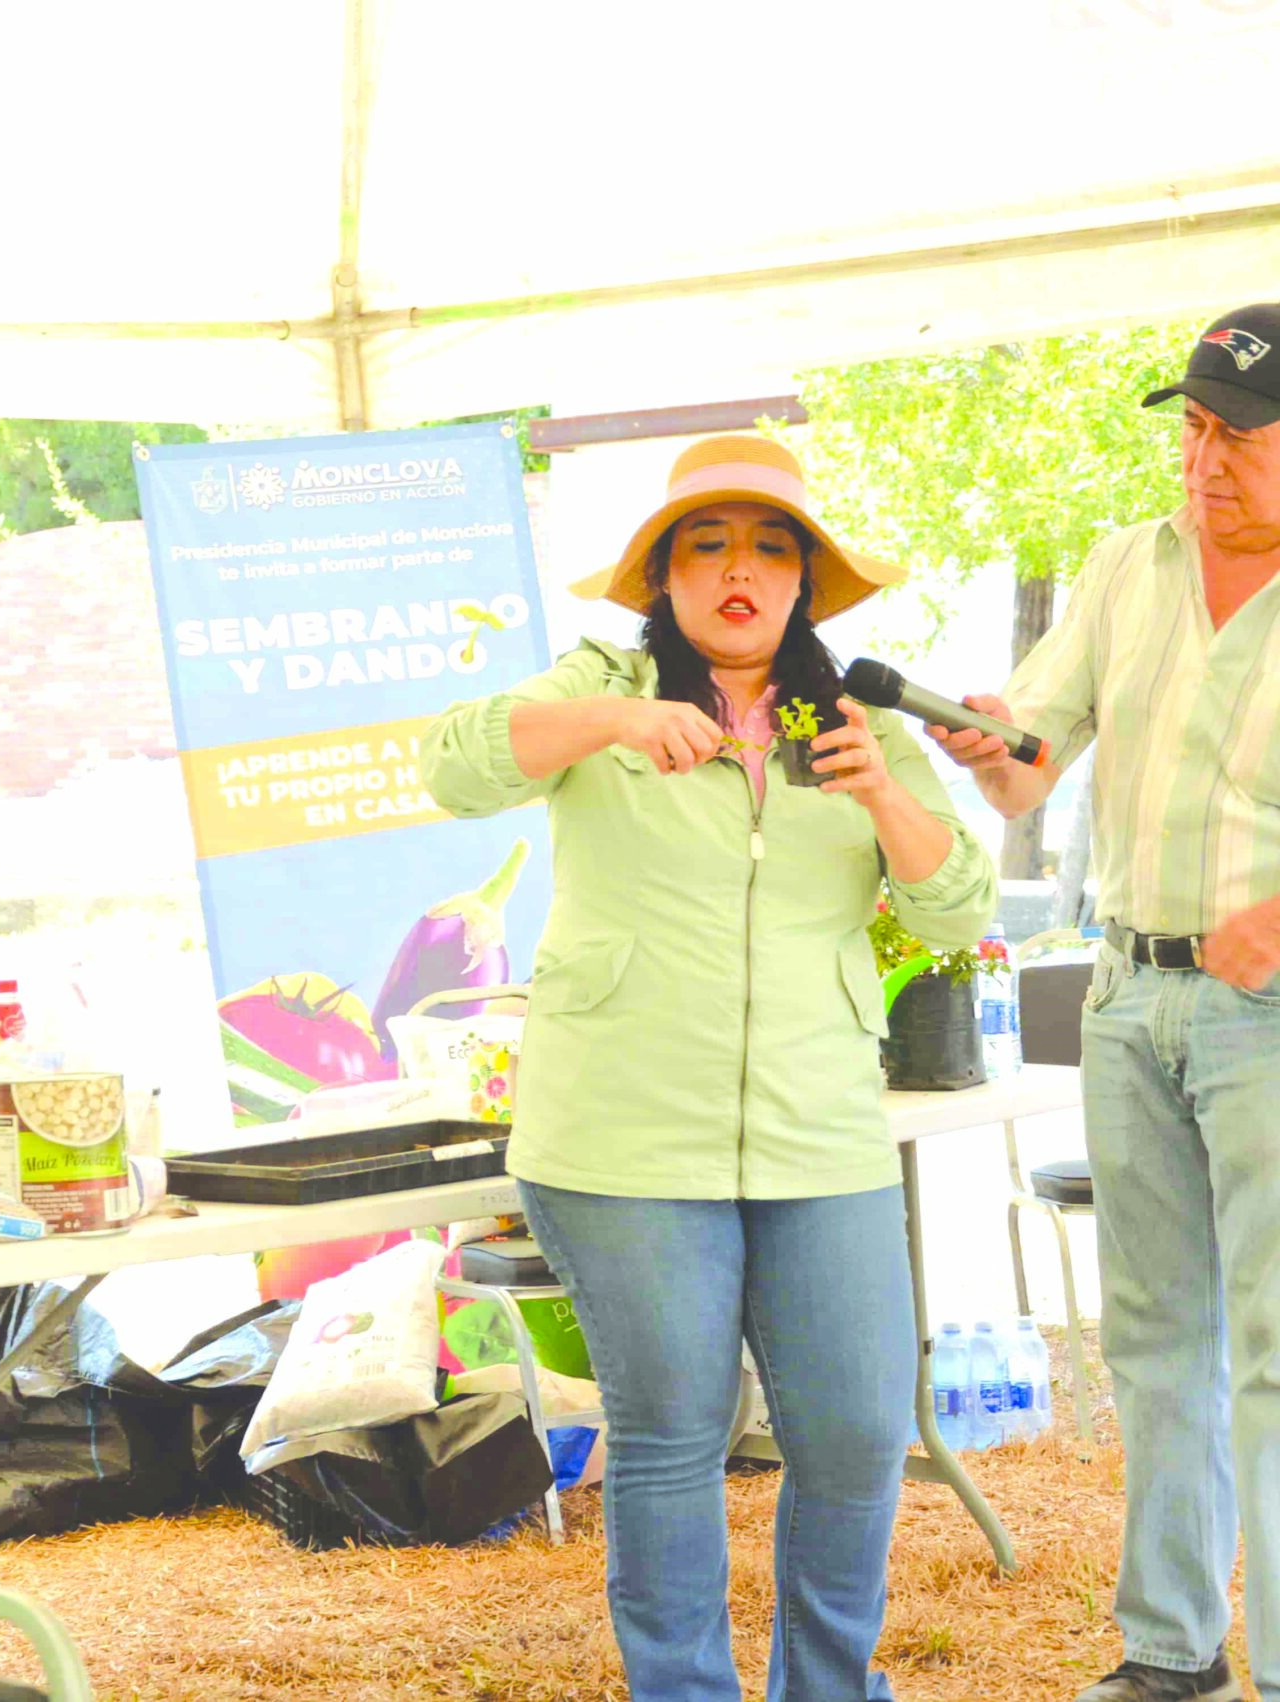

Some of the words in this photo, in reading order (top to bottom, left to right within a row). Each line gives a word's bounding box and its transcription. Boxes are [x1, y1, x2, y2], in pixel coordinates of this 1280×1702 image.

[292, 459, 463, 486] MONCLOVA
[292, 491, 375, 508] GOBIERNO
[381, 489, 401, 501] EN
[406, 482, 467, 499] ACCIÓN
[172, 541, 287, 563] Presidencia
[292, 532, 388, 556] Municipal
[392, 528, 417, 545] de
[422, 521, 514, 541] Monclova
[218, 566, 239, 582] te
[244, 559, 300, 580] invita
[304, 562, 316, 575] a
[320, 554, 389, 575] formar
[392, 550, 445, 572] parte
[448, 547, 473, 564] de
[175, 592, 530, 657] SEMBRANDO
[226, 658, 268, 694] Y
[284, 638, 489, 691] DANDO
[218, 743, 373, 785] ¡APRENDE
[380, 739, 404, 761] A
[220, 785, 261, 809] TU
[269, 769, 386, 804] PROPIO
[304, 803, 347, 827] EN
[353, 790, 438, 820] CASA
